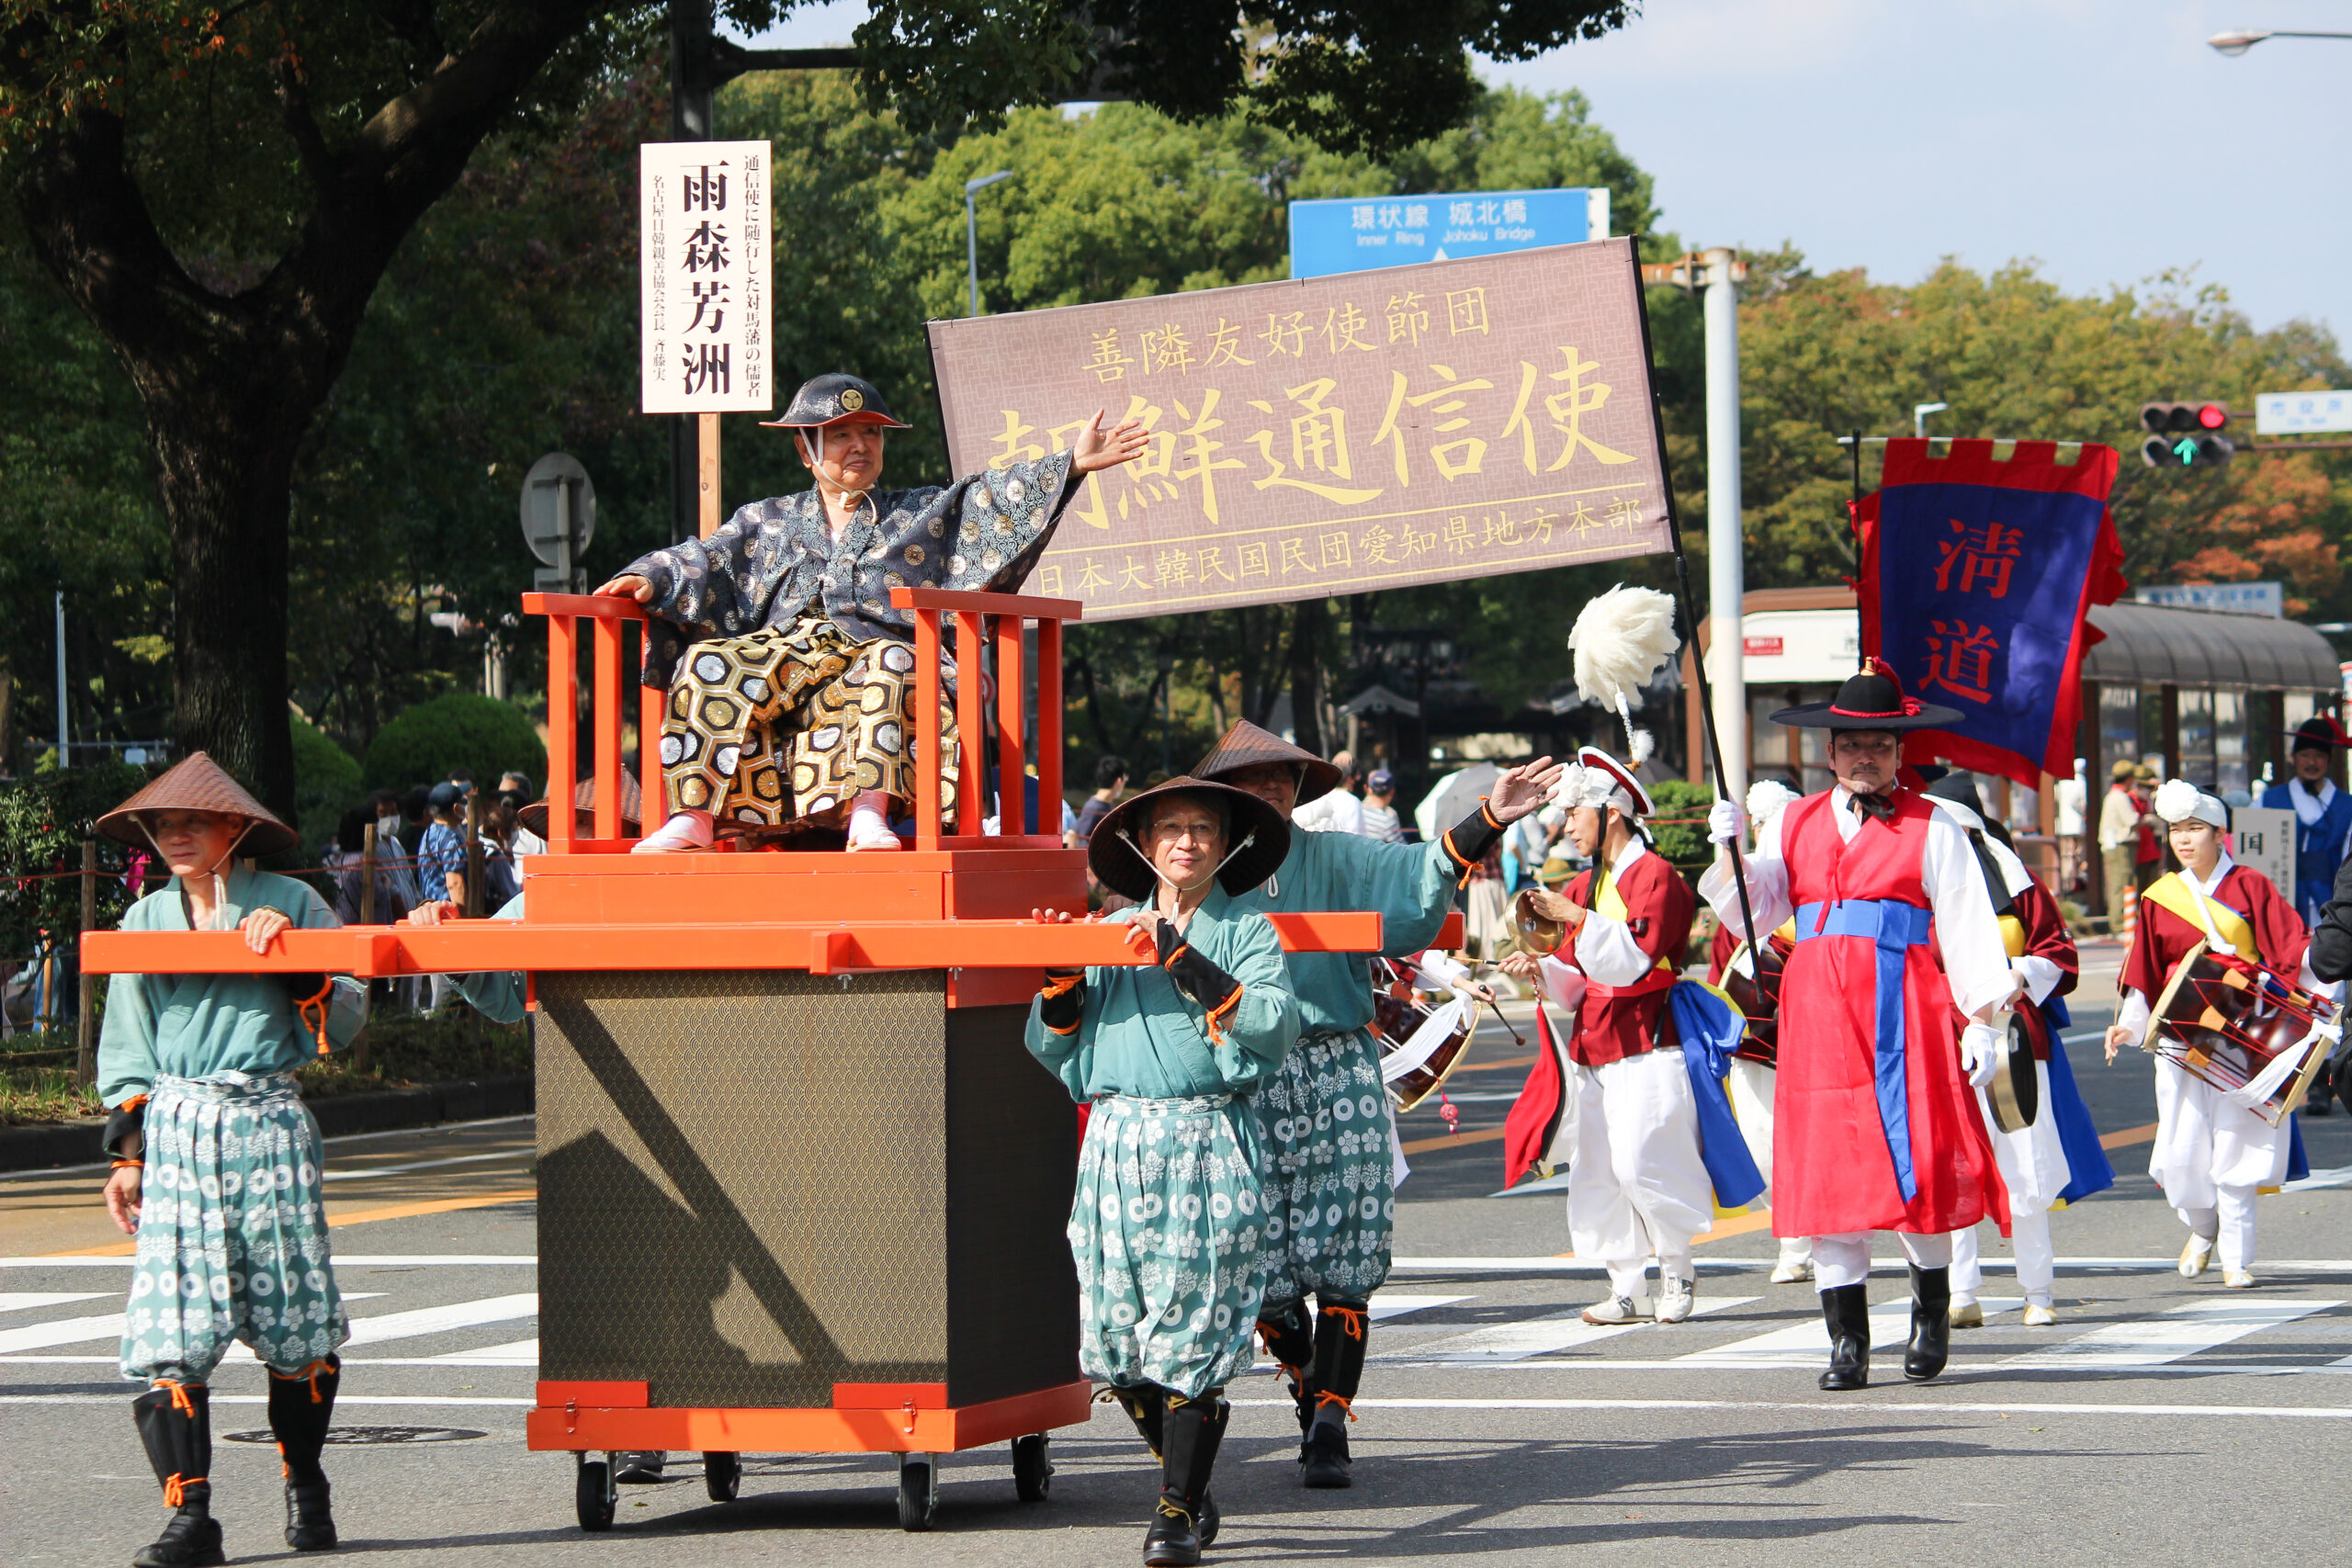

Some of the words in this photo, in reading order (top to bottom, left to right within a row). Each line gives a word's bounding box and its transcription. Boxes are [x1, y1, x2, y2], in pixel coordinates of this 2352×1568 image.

[652, 175, 666, 331] 名古屋日韓親善協会会長
[1351, 204, 1430, 230] 環状線
[1357, 233, 1388, 247] Inner
[1396, 231, 1425, 247] Ring
[1442, 229, 1488, 243] Johoku
[1495, 226, 1536, 242] Bridge
[1448, 198, 1528, 226] 城北橋
[680, 160, 731, 395] 雨森芳洲
[744, 154, 762, 398] 通信使に随行した対馬藩の儒者
[1081, 286, 1490, 384] 善隣友好使節団
[1021, 496, 1643, 597] 日本大韓民国民団愛知県地方本部
